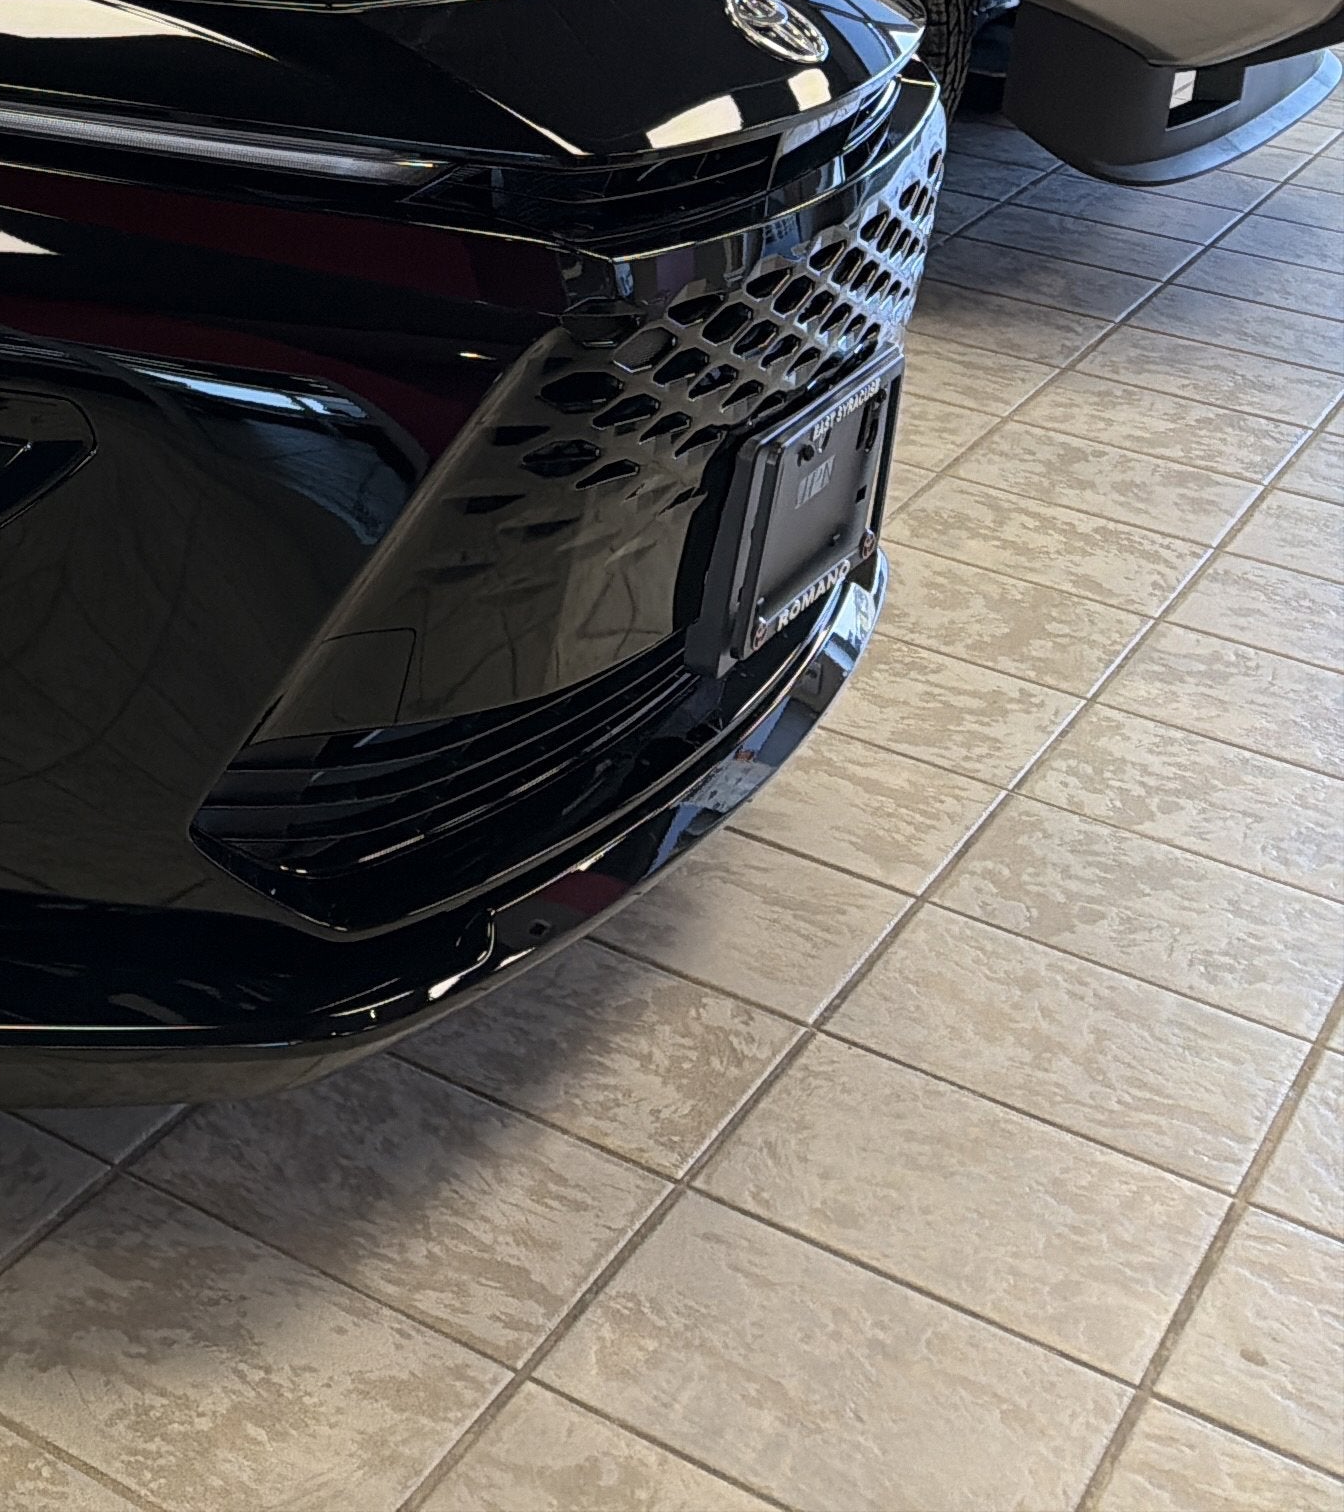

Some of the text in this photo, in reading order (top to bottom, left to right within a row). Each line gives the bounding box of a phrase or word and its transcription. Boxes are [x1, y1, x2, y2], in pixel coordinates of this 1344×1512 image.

[813, 378, 881, 441] EAST SYRACUSE
[777, 559, 851, 631] ROMANO
